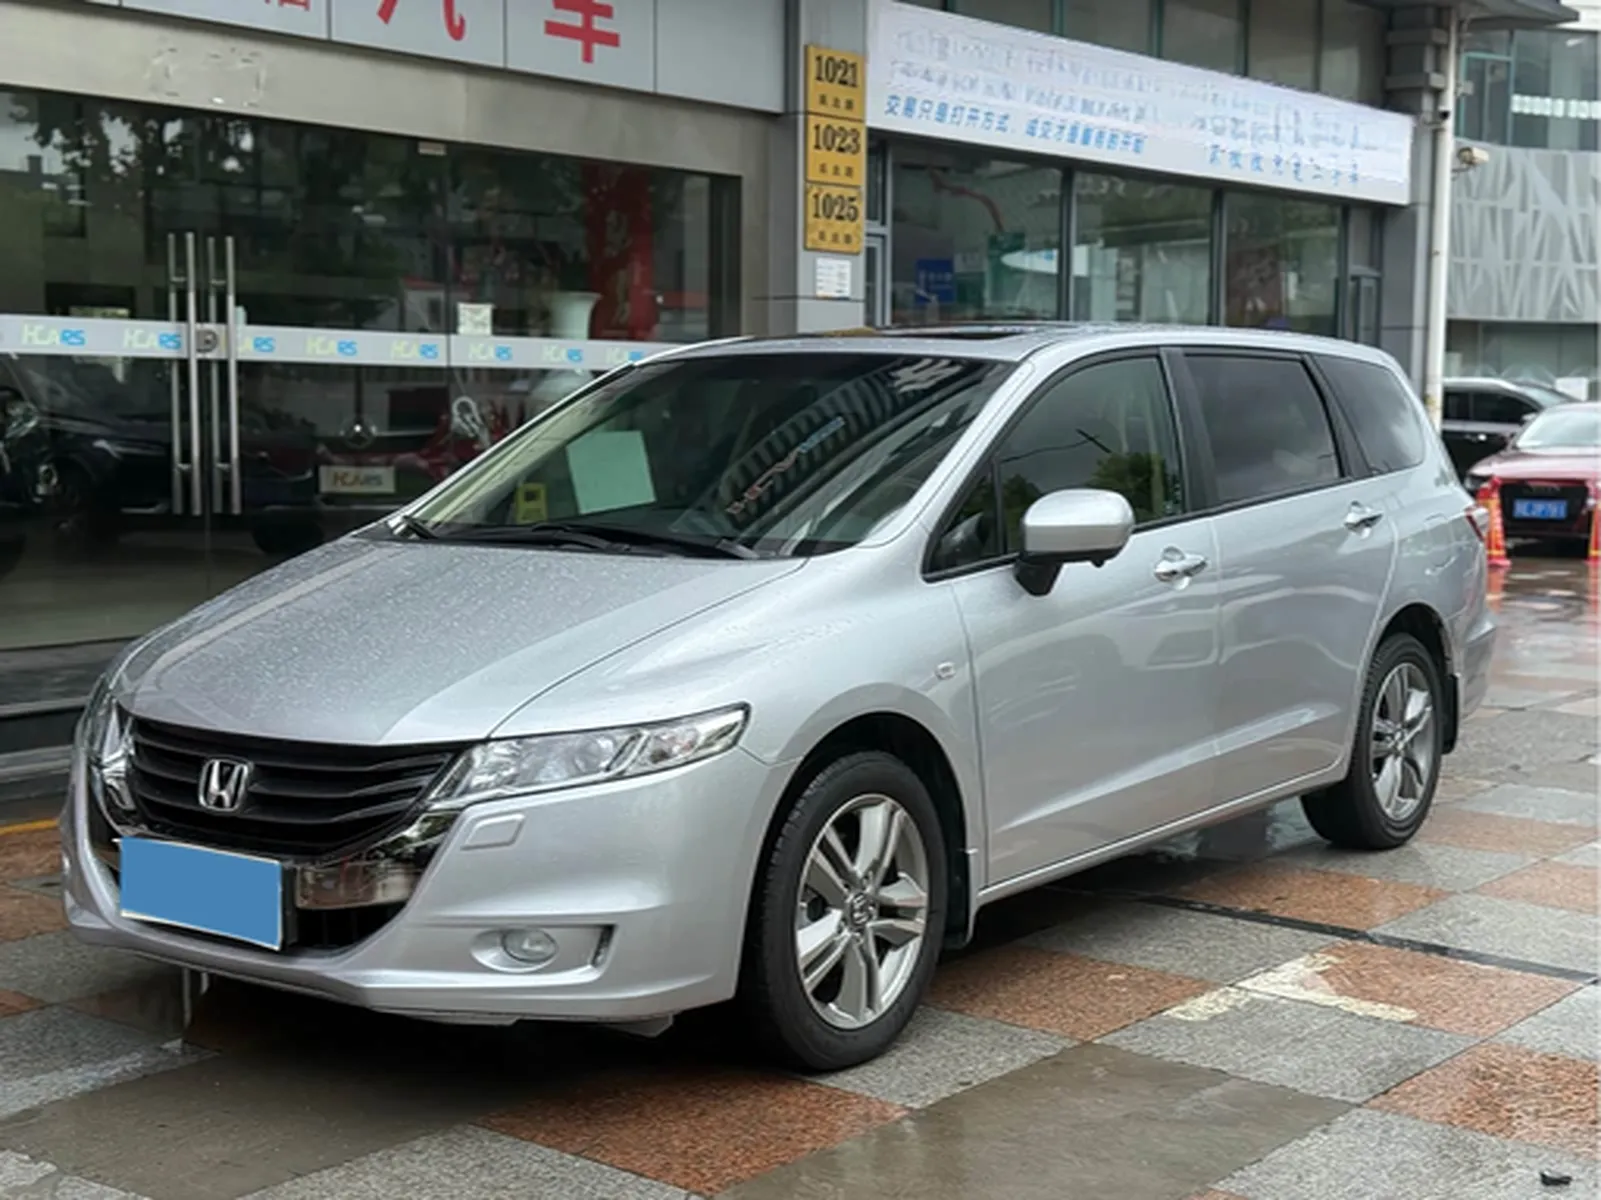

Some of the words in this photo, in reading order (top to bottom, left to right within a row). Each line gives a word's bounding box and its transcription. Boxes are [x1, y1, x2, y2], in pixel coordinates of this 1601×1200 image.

[815, 55, 857, 88] 1021
[813, 124, 860, 154] 1023
[812, 193, 858, 222] 1025
